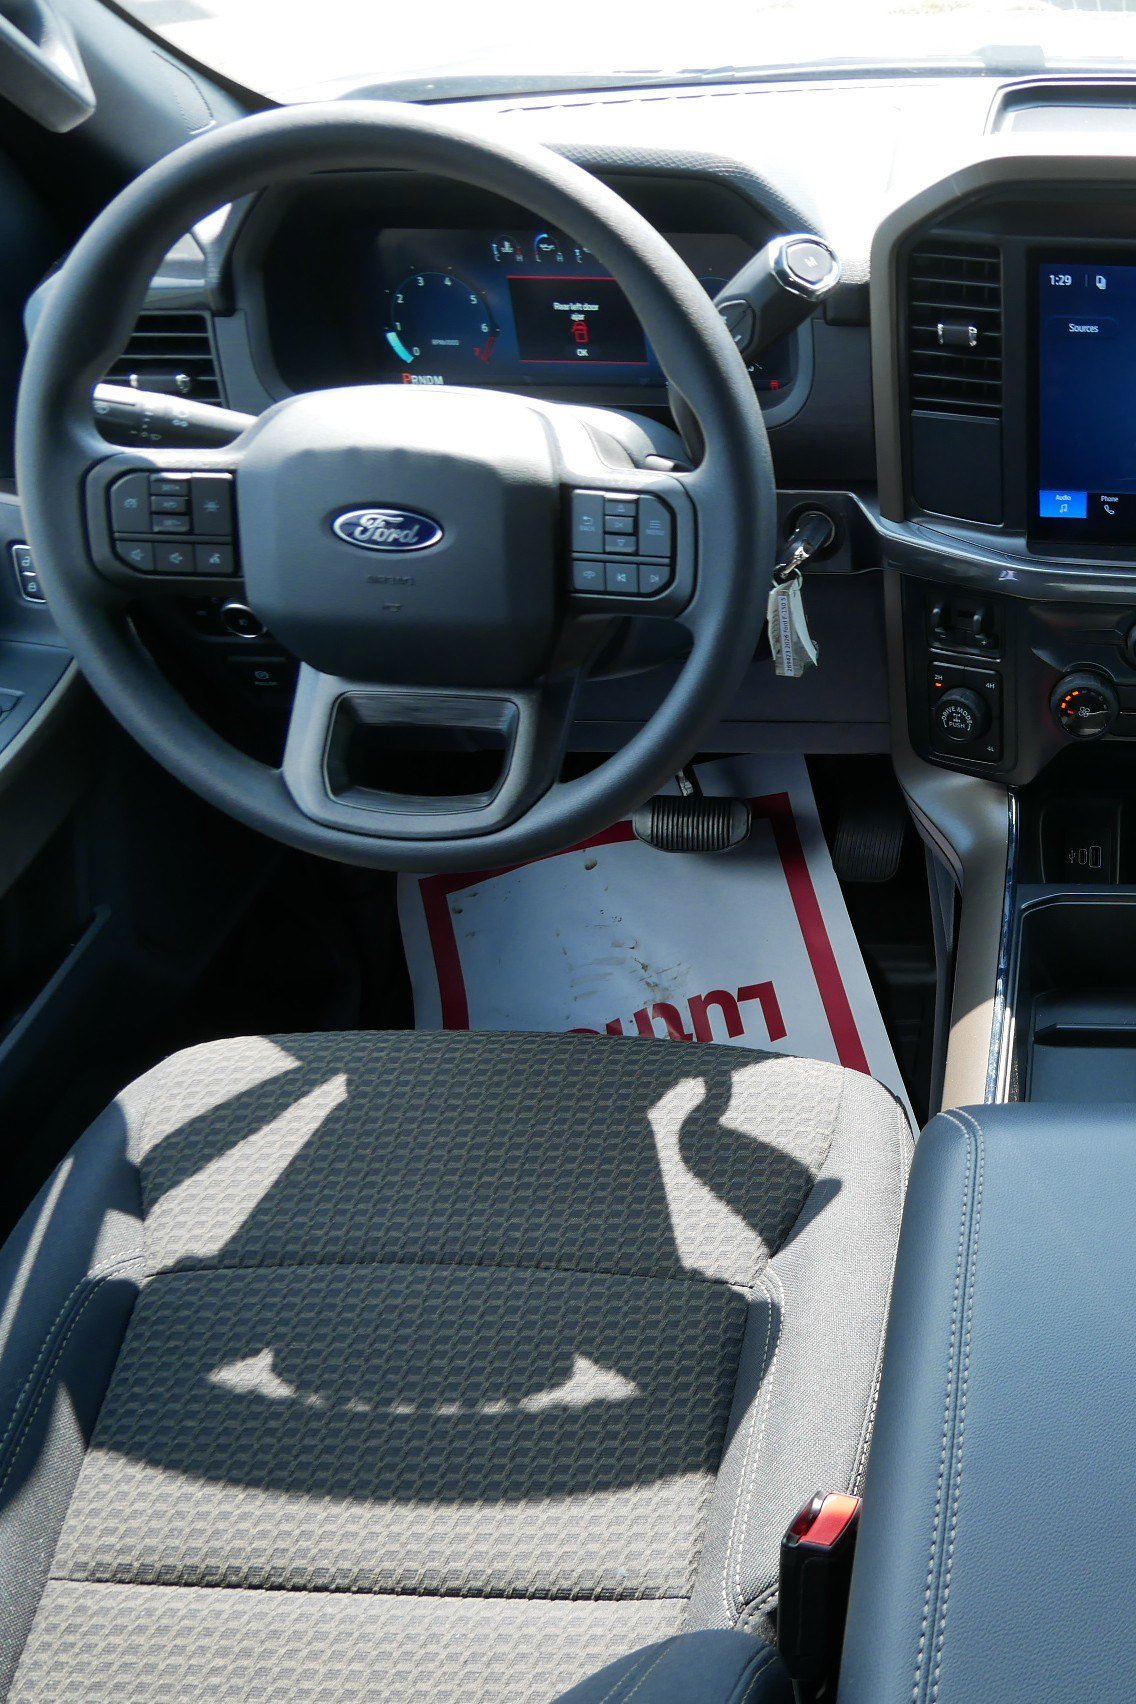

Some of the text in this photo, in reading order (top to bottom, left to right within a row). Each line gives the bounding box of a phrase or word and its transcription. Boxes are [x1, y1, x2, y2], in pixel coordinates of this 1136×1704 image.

[417, 277, 425, 287] 3
[444, 277, 452, 287] 4
[1049, 274, 1072, 286] 1:29
[396, 294, 404, 304] 2
[470, 295, 478, 305] 5
[481, 323, 489, 332] 6
[1069, 323, 1098, 333] Sources
[413, 347, 420, 356] 0
[576, 348, 589, 357] OK
[354, 513, 420, 544] Ford
[941, 706, 973, 724] DRIVE MODE
[949, 721, 966, 729] PUSH
